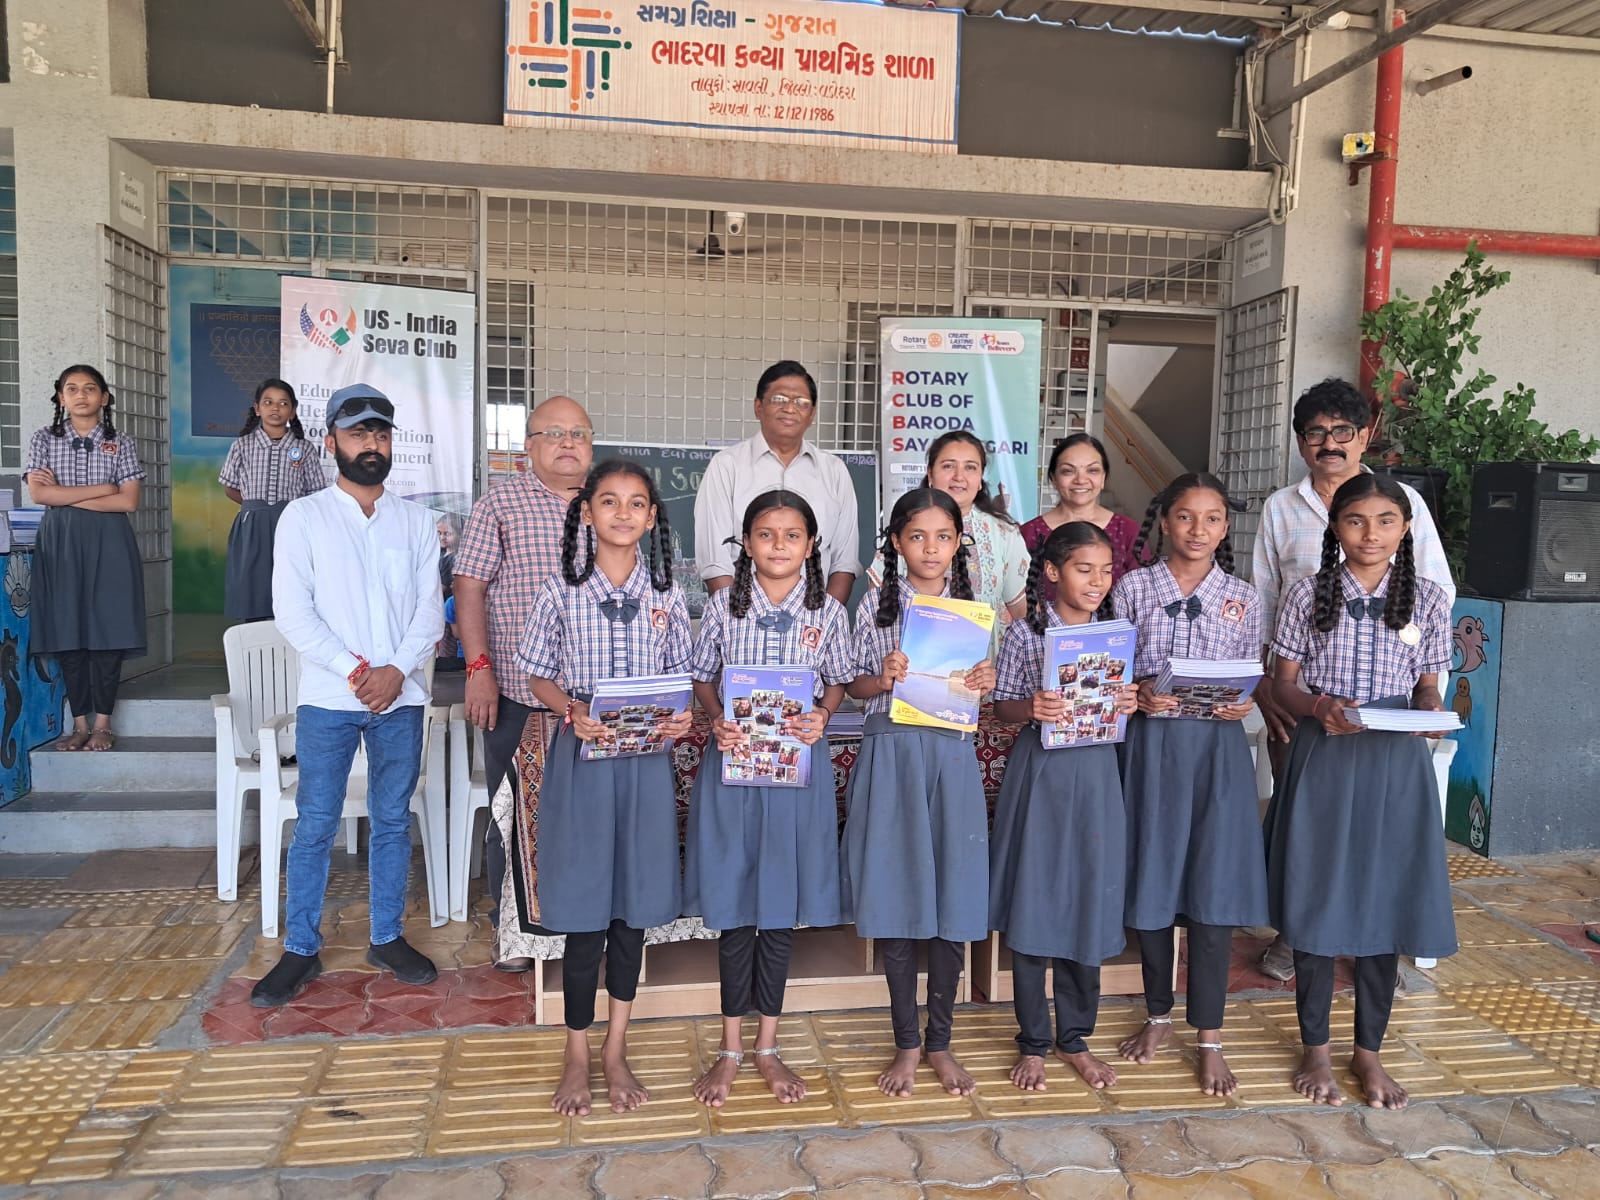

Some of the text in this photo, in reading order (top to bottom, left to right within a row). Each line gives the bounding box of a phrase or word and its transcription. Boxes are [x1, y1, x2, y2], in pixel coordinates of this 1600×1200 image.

[637, 4, 686, 28] સમગ્ર
[691, 0, 736, 29] શિક્ષા
[764, 13, 837, 42] ગુજરાત
[651, 40, 935, 81] ભાદરવા કન્યા પ્રાથમિક શાળા
[708, 102, 750, 118] સ્થાપના
[773, 105, 835, 122] 12/12/1986
[364, 309, 390, 330] US
[406, 312, 457, 336] India
[362, 333, 457, 359] Seva Club
[892, 371, 969, 386] ROTARY
[892, 393, 974, 408] CLUB OF
[892, 415, 975, 431] BARODA
